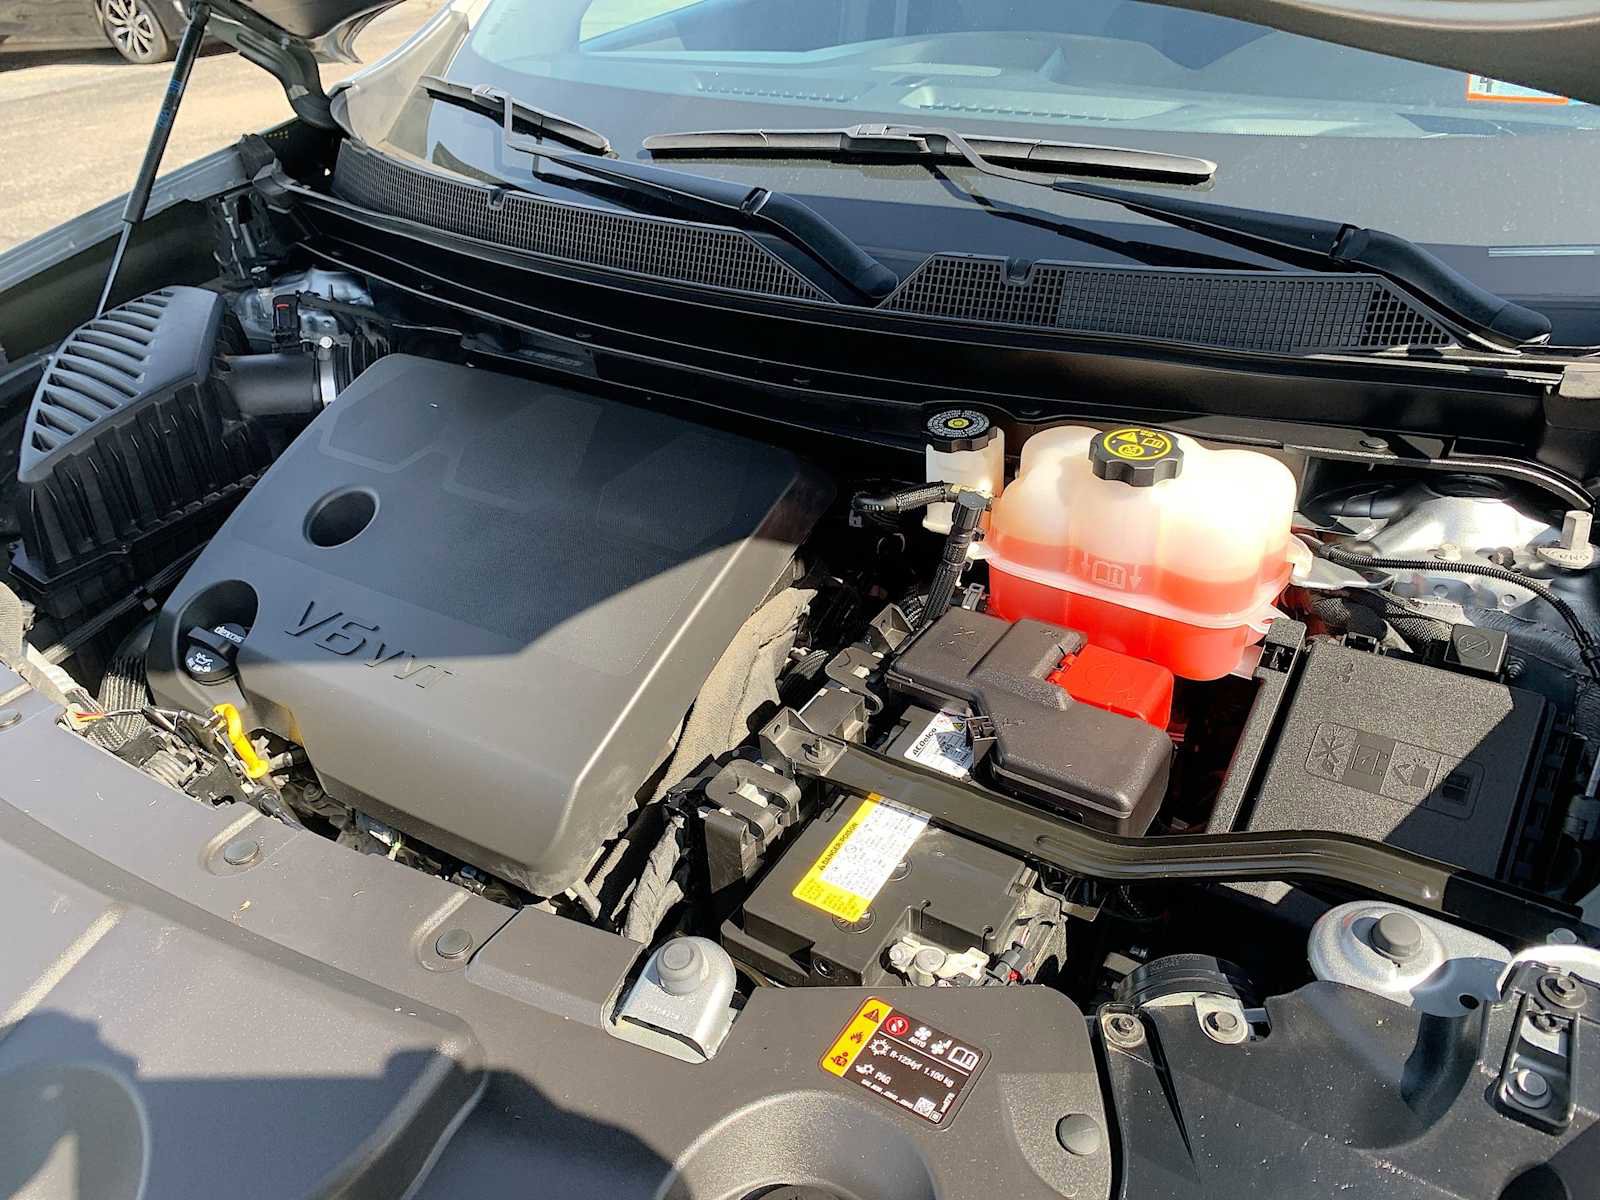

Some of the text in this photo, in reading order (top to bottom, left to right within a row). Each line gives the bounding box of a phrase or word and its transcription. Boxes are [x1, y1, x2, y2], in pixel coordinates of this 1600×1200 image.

[214, 626, 245, 643] dexos
[908, 1036, 927, 1049] AUTO
[889, 1050, 955, 1089] R-1234yf 1.100 kg
[874, 1071, 892, 1086] PAG
